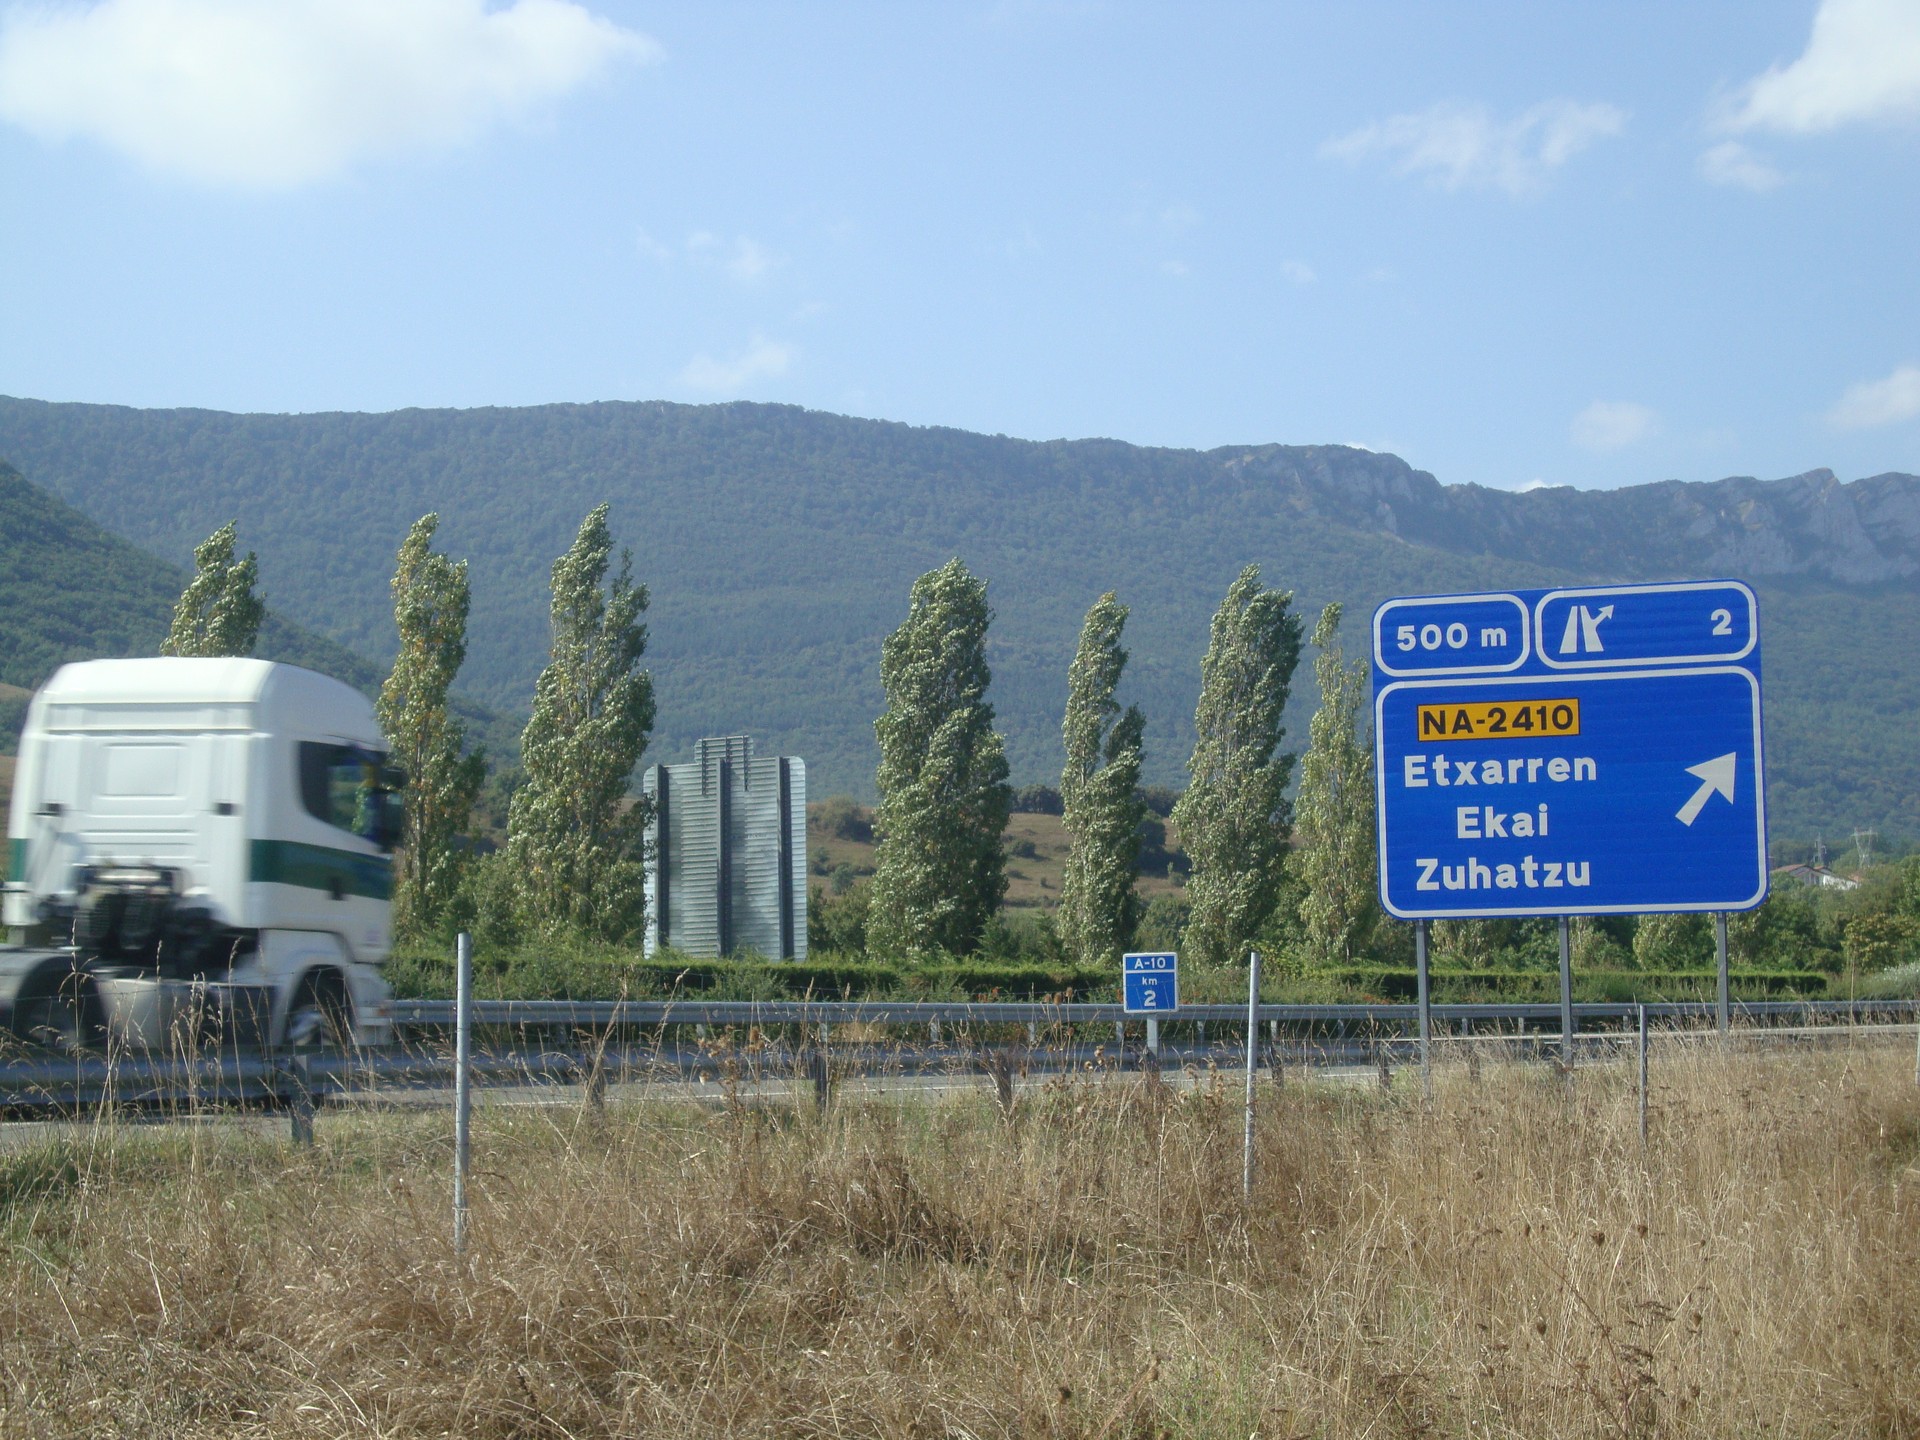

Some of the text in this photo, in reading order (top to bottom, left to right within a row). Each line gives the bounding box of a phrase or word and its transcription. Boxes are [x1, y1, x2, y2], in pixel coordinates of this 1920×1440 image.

[1710, 608, 1732, 636] 2
[1397, 623, 1507, 651] 500 m
[1423, 704, 1574, 735] NA-2410
[1404, 754, 1597, 788] Etxarren
[1457, 804, 1549, 839] Ekai
[1416, 855, 1591, 891] Zuhatzu
[1134, 957, 1166, 969] A-10
[1142, 977, 1157, 985] km
[1144, 990, 1156, 1007] 2
